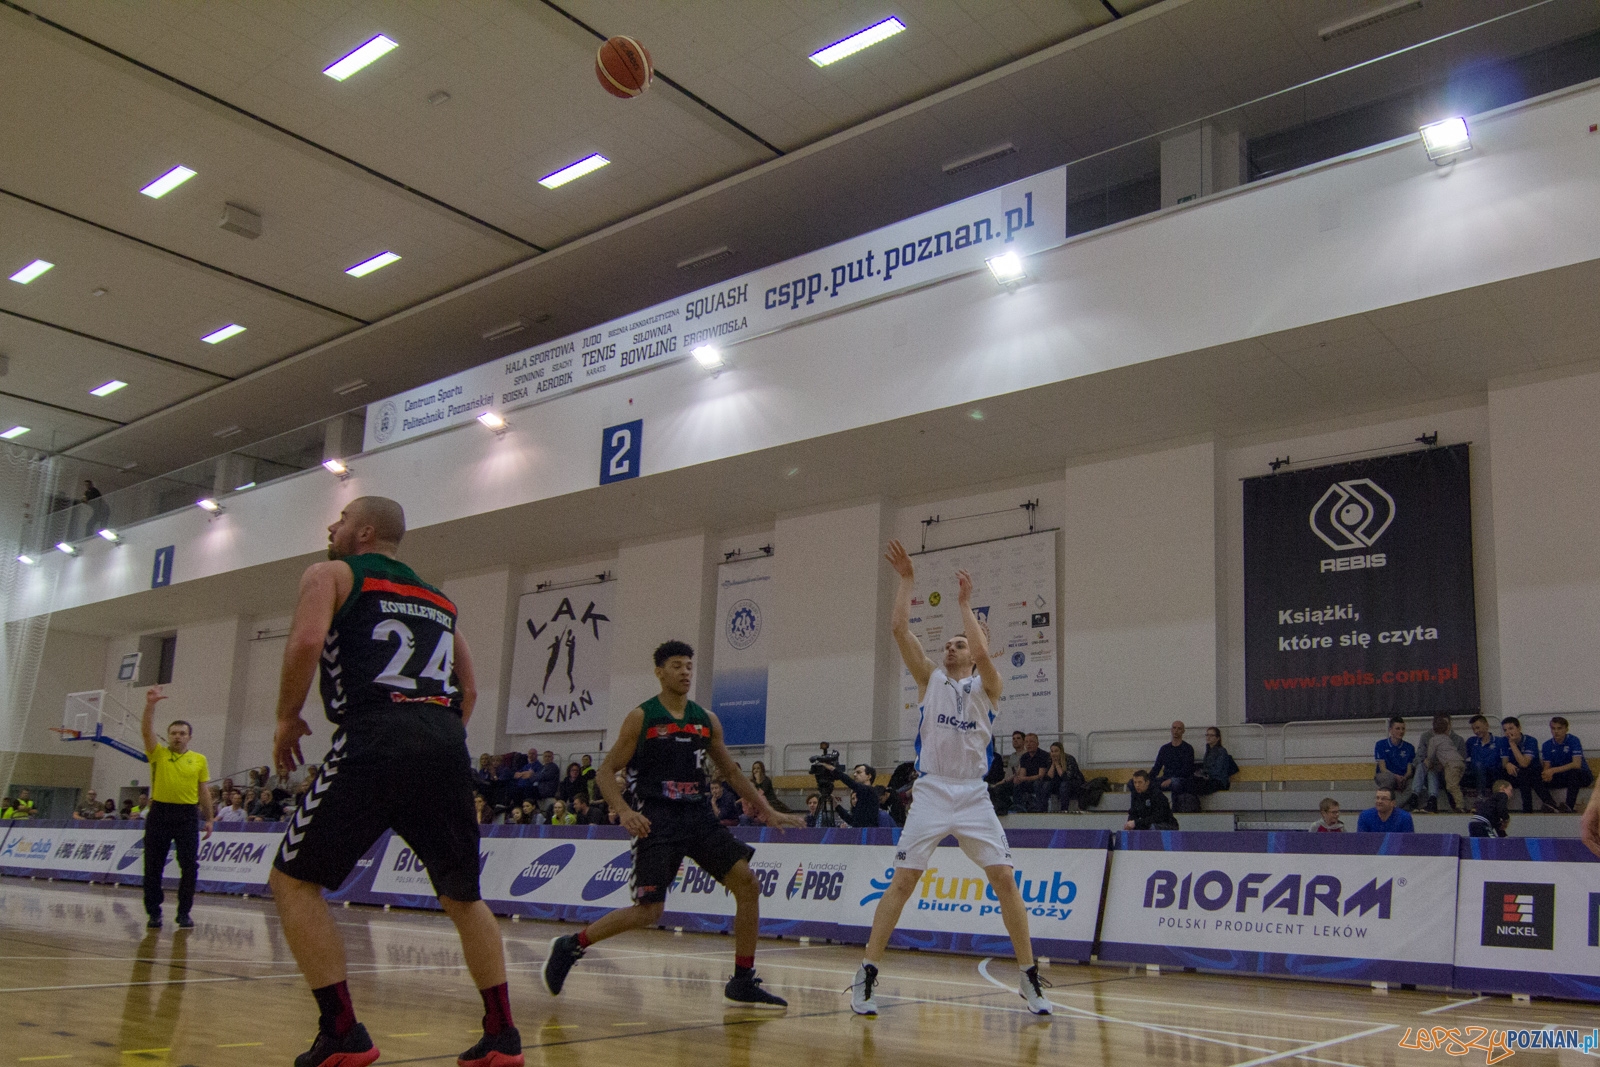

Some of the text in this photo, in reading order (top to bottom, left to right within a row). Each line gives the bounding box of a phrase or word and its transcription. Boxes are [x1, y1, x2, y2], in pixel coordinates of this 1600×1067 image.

[765, 192, 1034, 309] cspp.put.poznan.pl
[685, 283, 748, 321] SQUASH
[582, 333, 602, 348] JUDO
[633, 323, 672, 344] SIŁOWNIA
[683, 316, 748, 347] ERGOWIOSŁA
[505, 342, 575, 375] HALA SPORTOWA
[582, 343, 616, 367] TENIS
[620, 336, 677, 367] BOWLING
[586, 364, 607, 376] KARATE
[404, 385, 463, 412] Centrum Sportu
[502, 371, 573, 404] BOISKA AEROBIK
[402, 409, 444, 431] Politechniki
[447, 393, 495, 418] Poznańskiej
[609, 429, 632, 476] 2
[156, 551, 167, 583] 1
[1320, 553, 1387, 573] REBIS
[379, 599, 453, 630] KOWALEWSKI
[1278, 604, 1360, 625] Książki,
[1278, 625, 1438, 651] które się czyta
[371, 618, 459, 695] 24
[1263, 664, 1459, 691] www.rebis.com.pl
[526, 689, 594, 723] POZNAŃ
[200, 841, 267, 864] BIOFARM
[522, 861, 560, 878] atrem
[808, 862, 847, 872] fundacja
[801, 870, 844, 901] PBG
[1143, 870, 1393, 920] BIOFARM
[918, 899, 972, 912] biuro
[1158, 917, 1368, 938] POLSKI PRODUCENT LEKÓW
[1496, 925, 1538, 937] NICKEL
